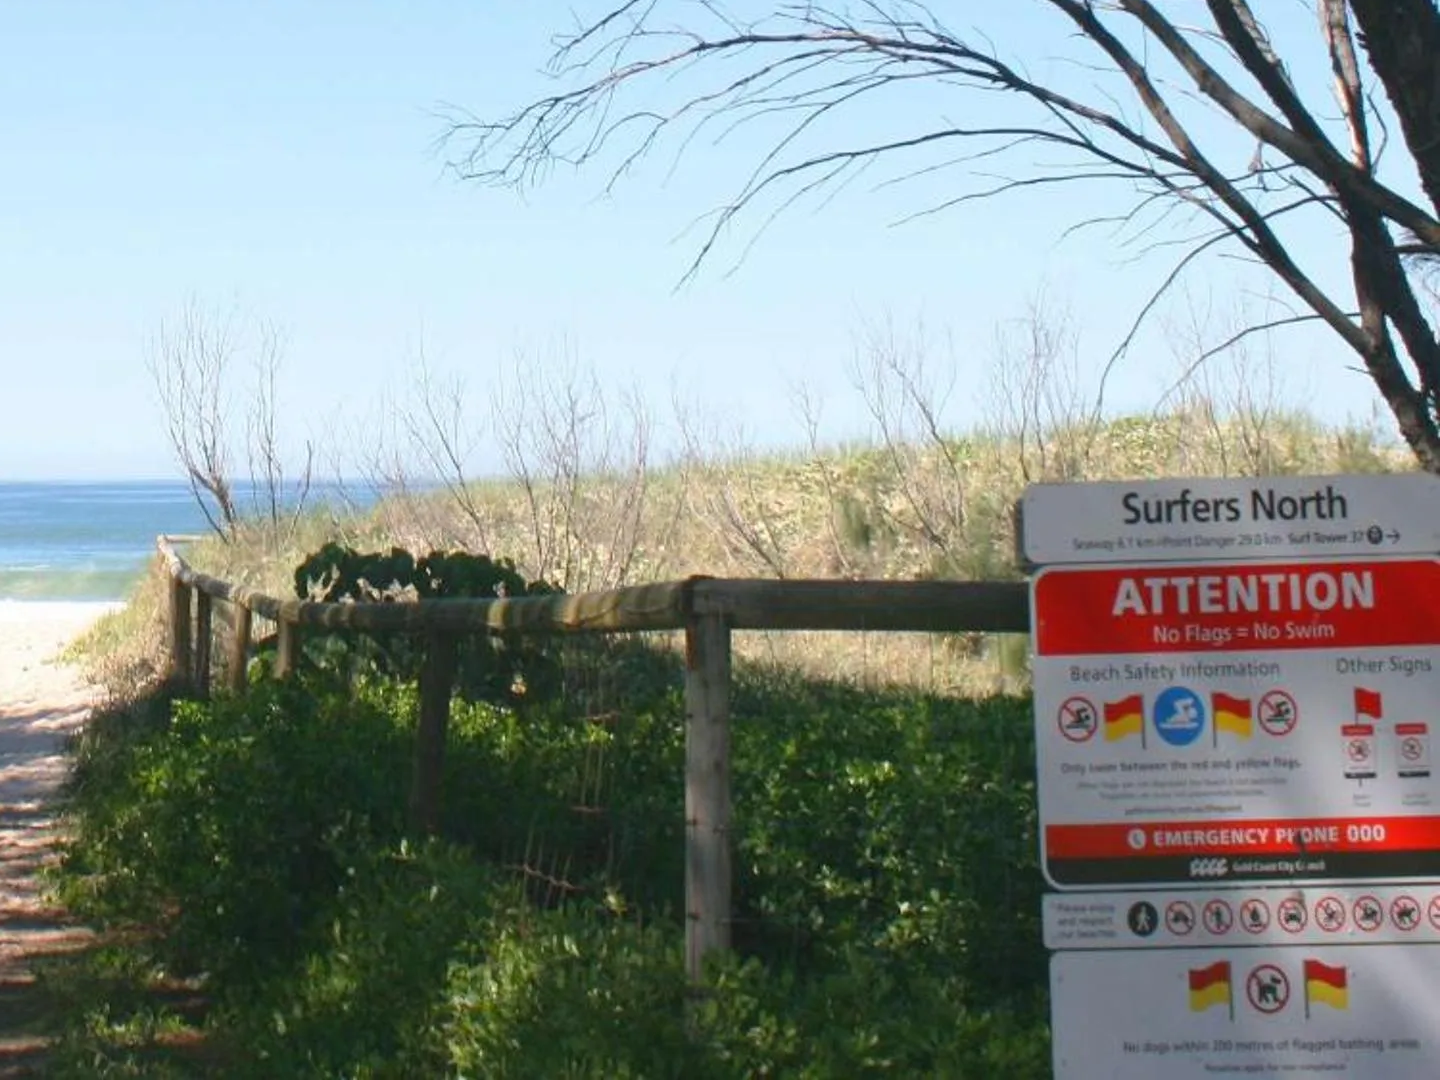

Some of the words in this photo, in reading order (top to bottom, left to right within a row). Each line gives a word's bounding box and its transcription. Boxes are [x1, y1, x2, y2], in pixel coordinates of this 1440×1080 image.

[1122, 489, 1240, 524] Surfers
[1252, 486, 1347, 520] North
[1112, 571, 1375, 616] ATTENTION
[1154, 626, 1178, 643] No
[1185, 624, 1232, 647] Flags
[1254, 623, 1280, 640] No
[1285, 621, 1335, 639] Swim
[1069, 664, 1120, 682] Beach
[1124, 662, 1176, 682] Safety
[1180, 660, 1280, 678] Information
[1336, 656, 1385, 675] Other
[1389, 654, 1433, 677] Signs
[1153, 827, 1270, 847] EMERGENCY
[1346, 824, 1386, 842] 000
